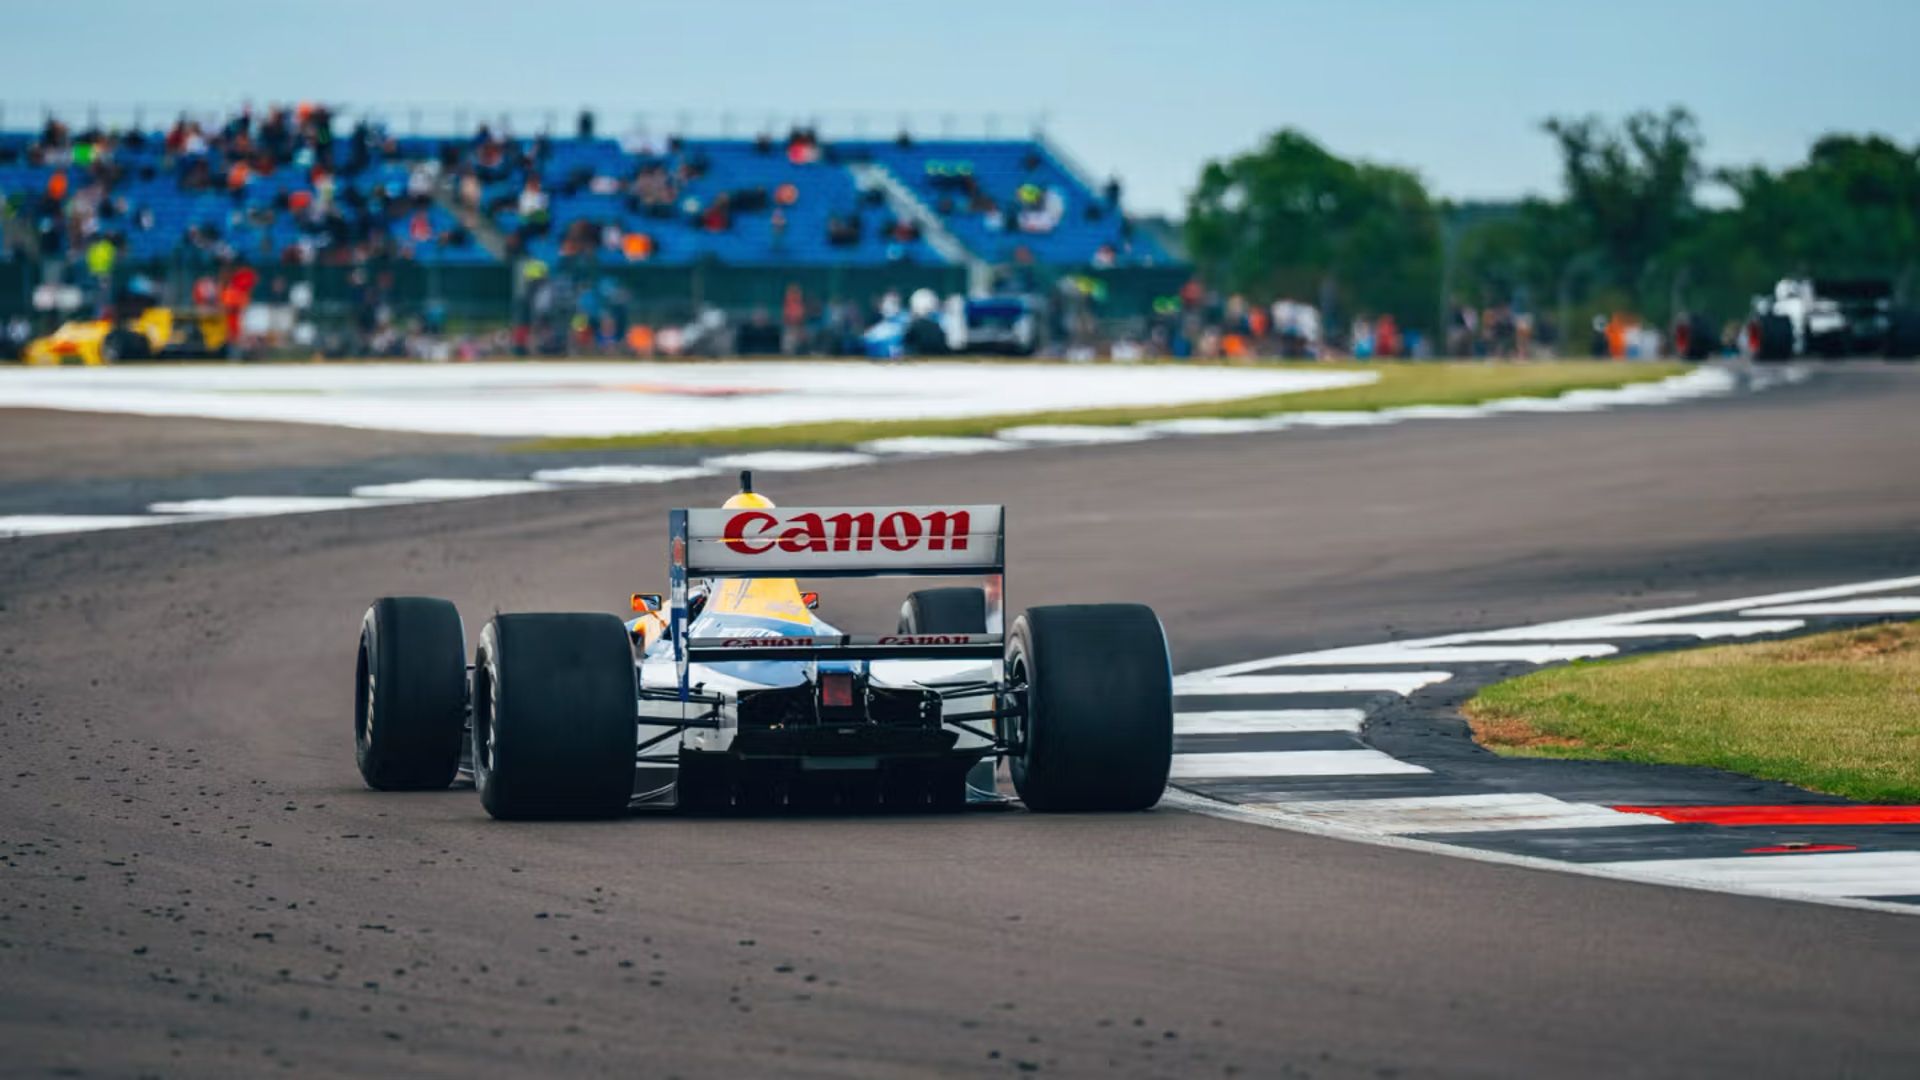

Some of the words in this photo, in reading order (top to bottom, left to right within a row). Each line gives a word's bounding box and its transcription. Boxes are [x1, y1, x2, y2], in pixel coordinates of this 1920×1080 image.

[723, 510, 971, 554] Canon
[721, 638, 813, 648] Canon
[878, 635, 970, 646] Canon
